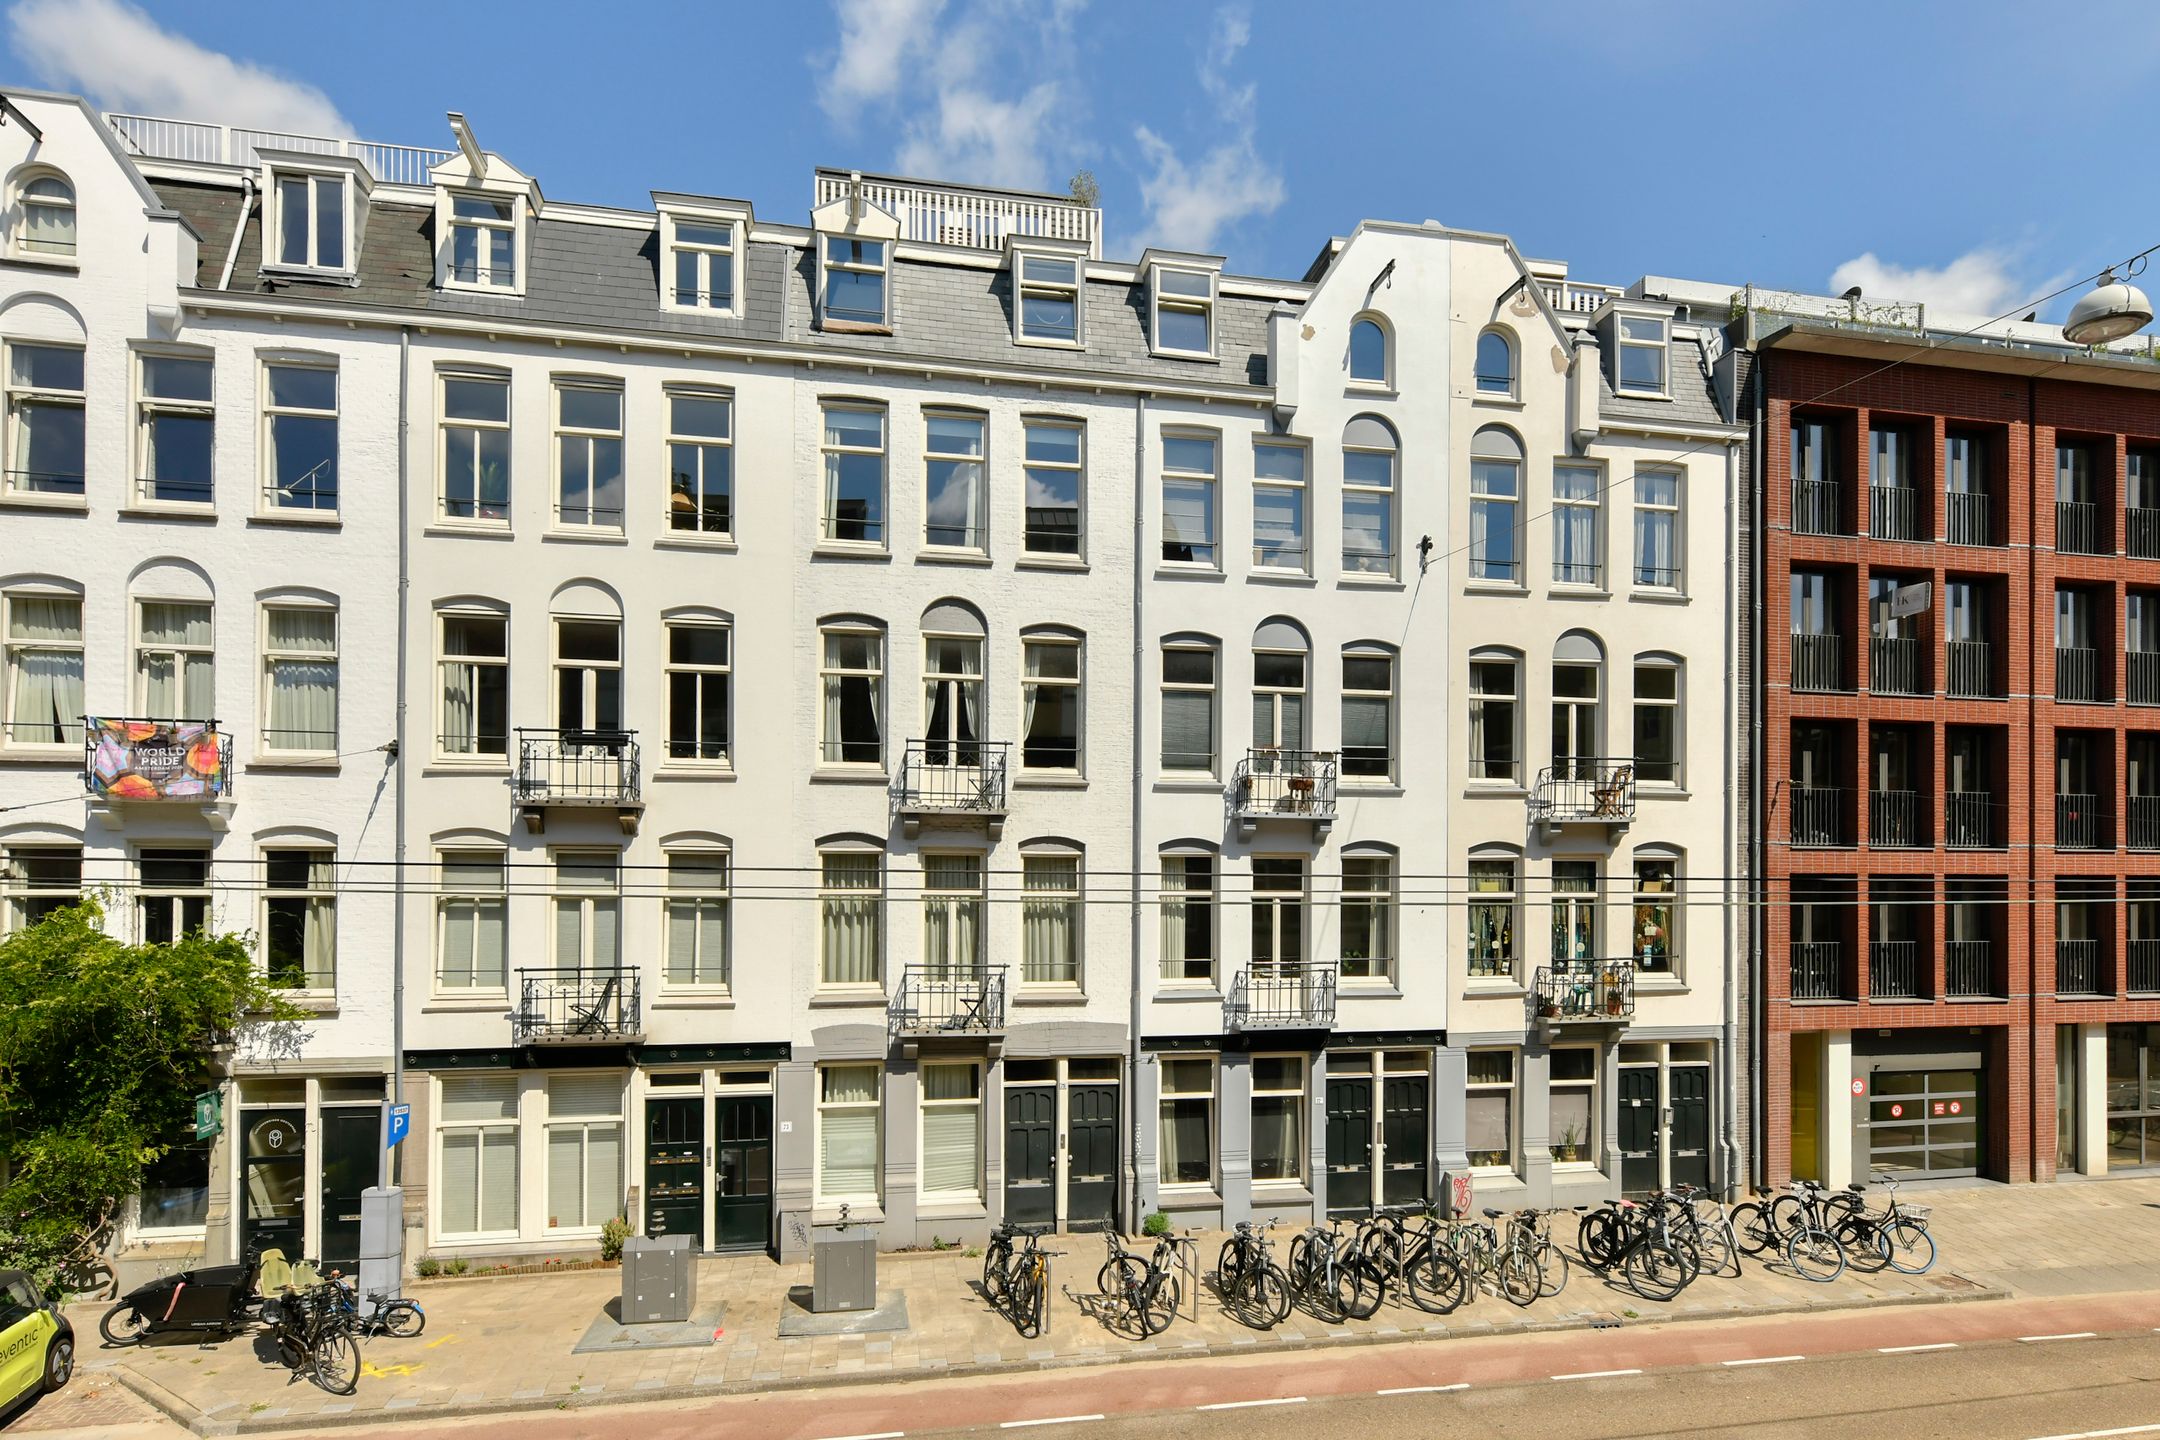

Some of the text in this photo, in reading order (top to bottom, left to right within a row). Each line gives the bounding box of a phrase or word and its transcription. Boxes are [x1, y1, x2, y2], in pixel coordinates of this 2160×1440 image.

[134, 747, 186, 757] WORLD
[141, 757, 180, 766] PRIDE
[394, 1117, 403, 1134] P
